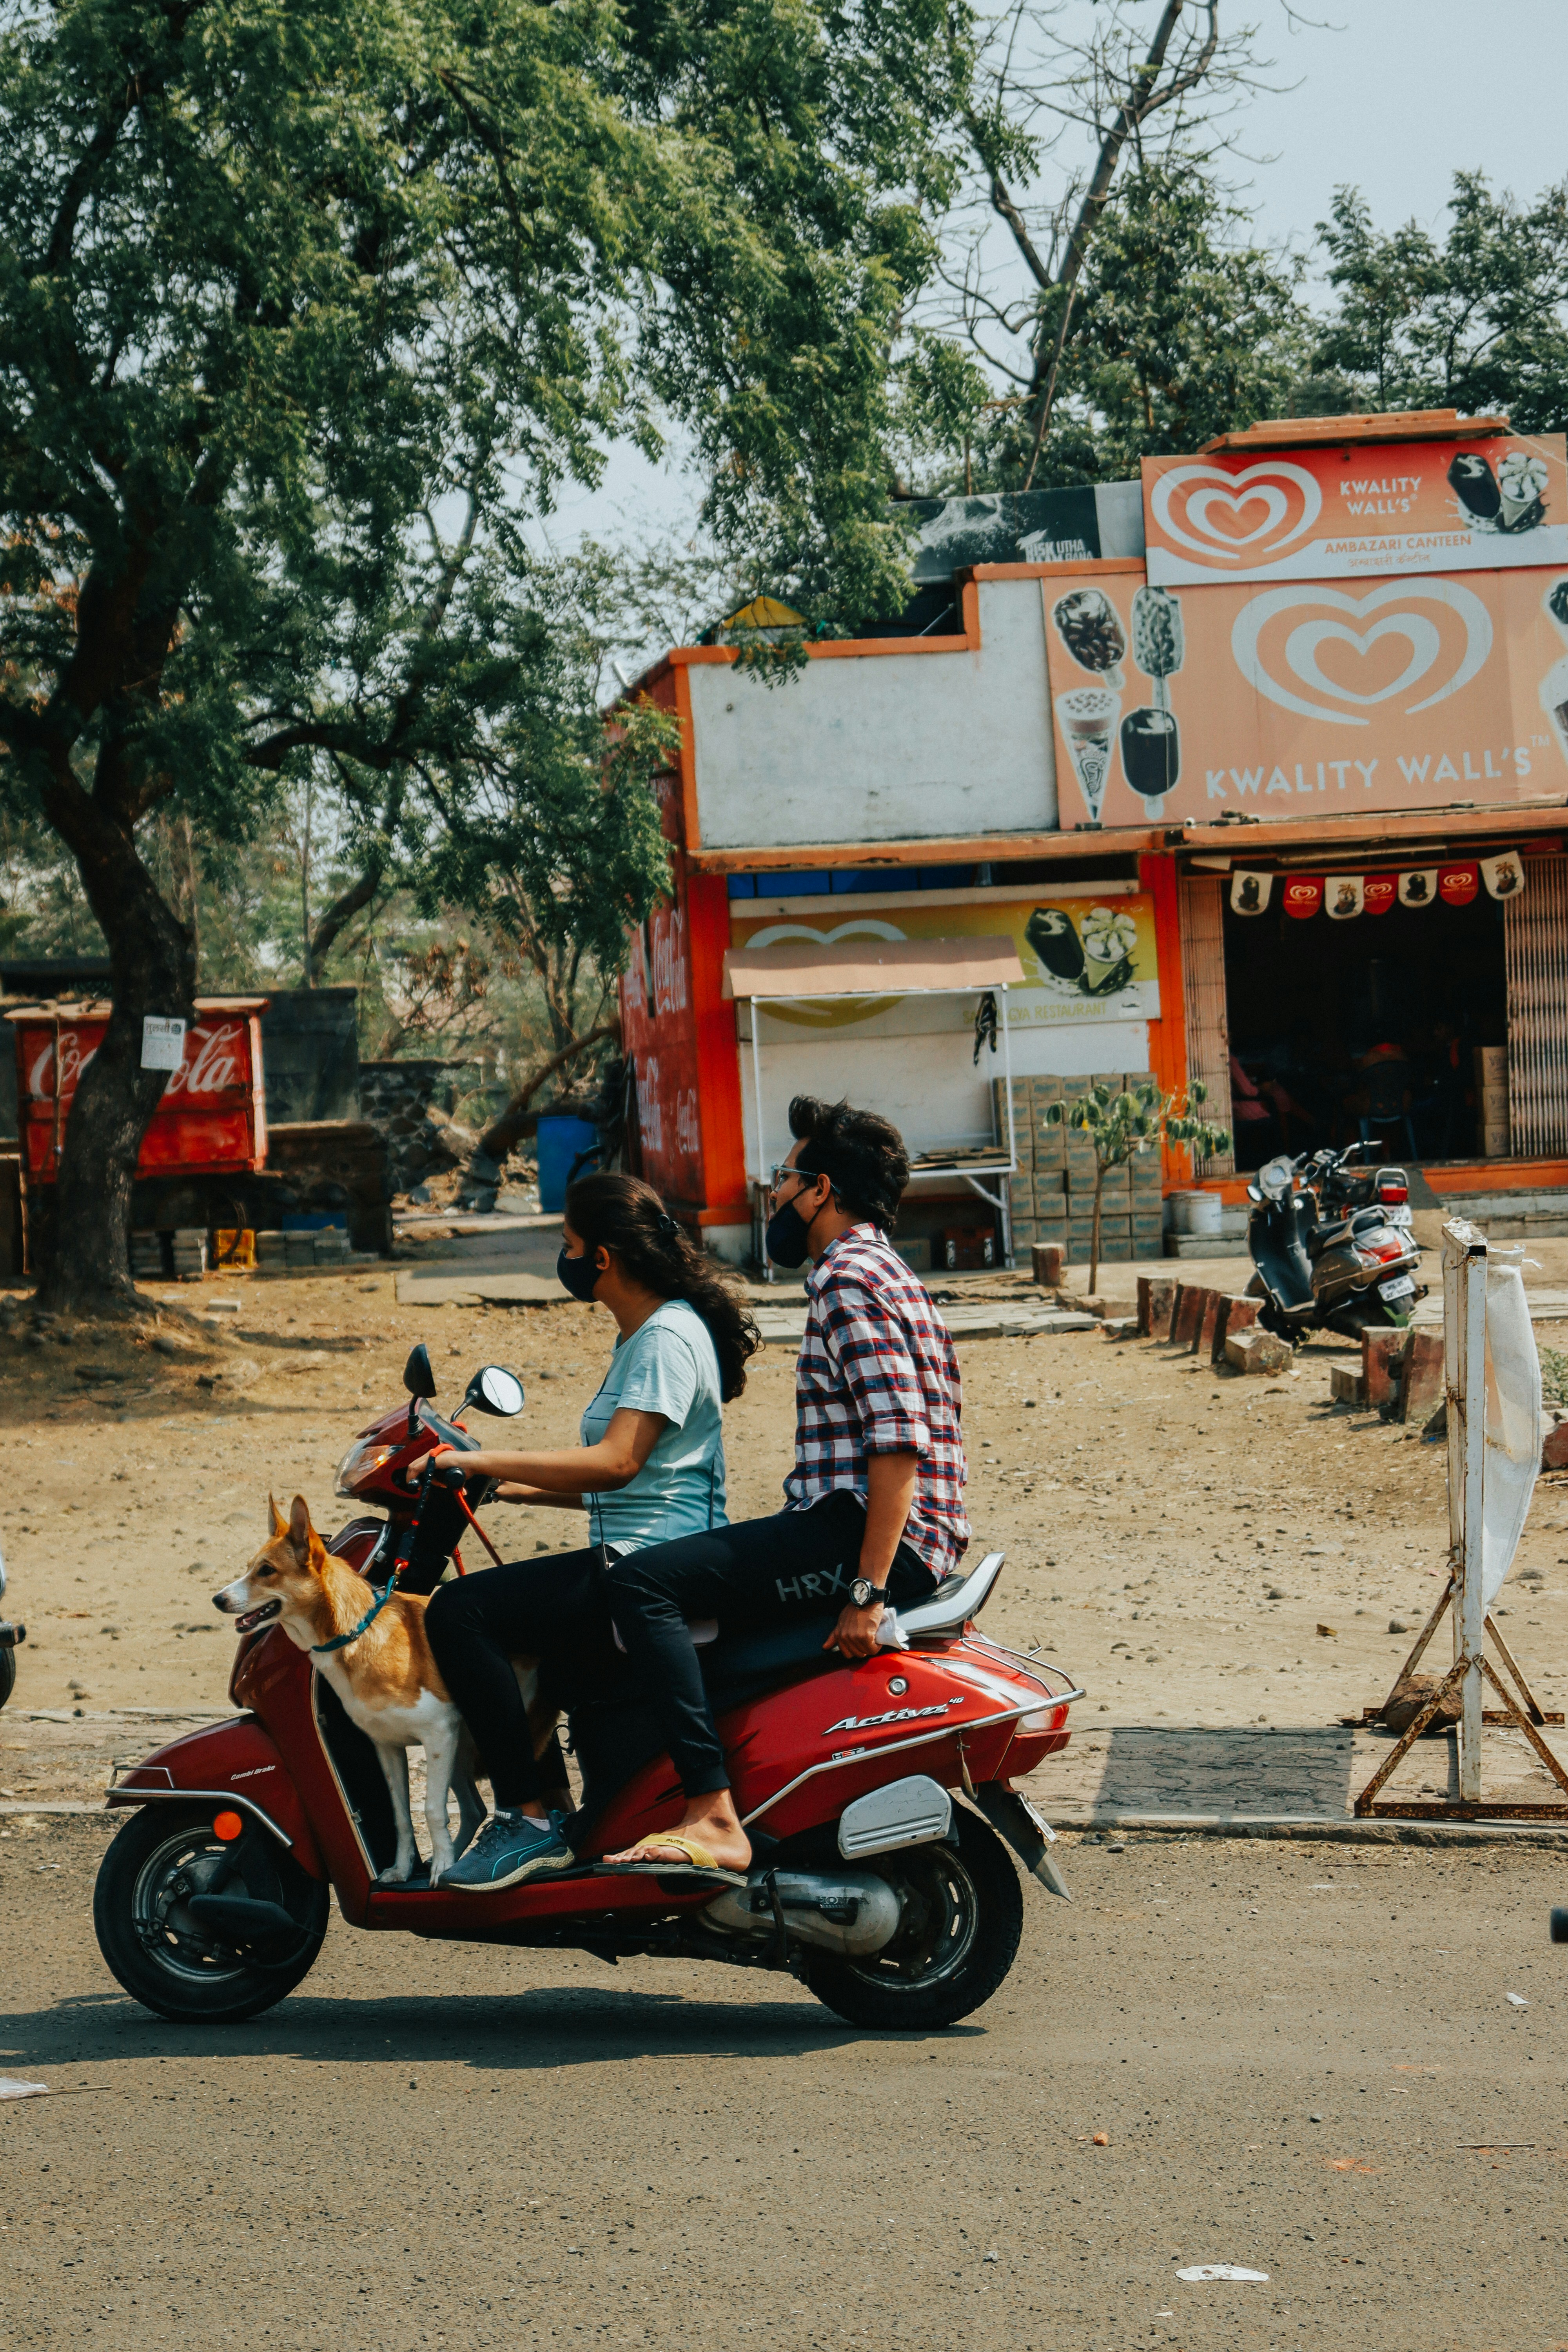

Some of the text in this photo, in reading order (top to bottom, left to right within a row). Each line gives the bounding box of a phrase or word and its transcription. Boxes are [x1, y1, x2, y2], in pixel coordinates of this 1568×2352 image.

[1340, 477, 1421, 495] KWALITY
[1347, 498, 1410, 515] WALL'S
[1325, 534, 1471, 554] AMBAZARI CANTEEN
[1205, 758, 1379, 799] KWALITY
[1396, 747, 1531, 784] WALL'S
[1034, 1001, 1107, 1019] RESTAURANT
[775, 1563, 849, 1602] HRX
[821, 1696, 965, 1735] Activa 4G
[833, 1748, 860, 1760] HET
[230, 1765, 276, 1780] Combi Brake
